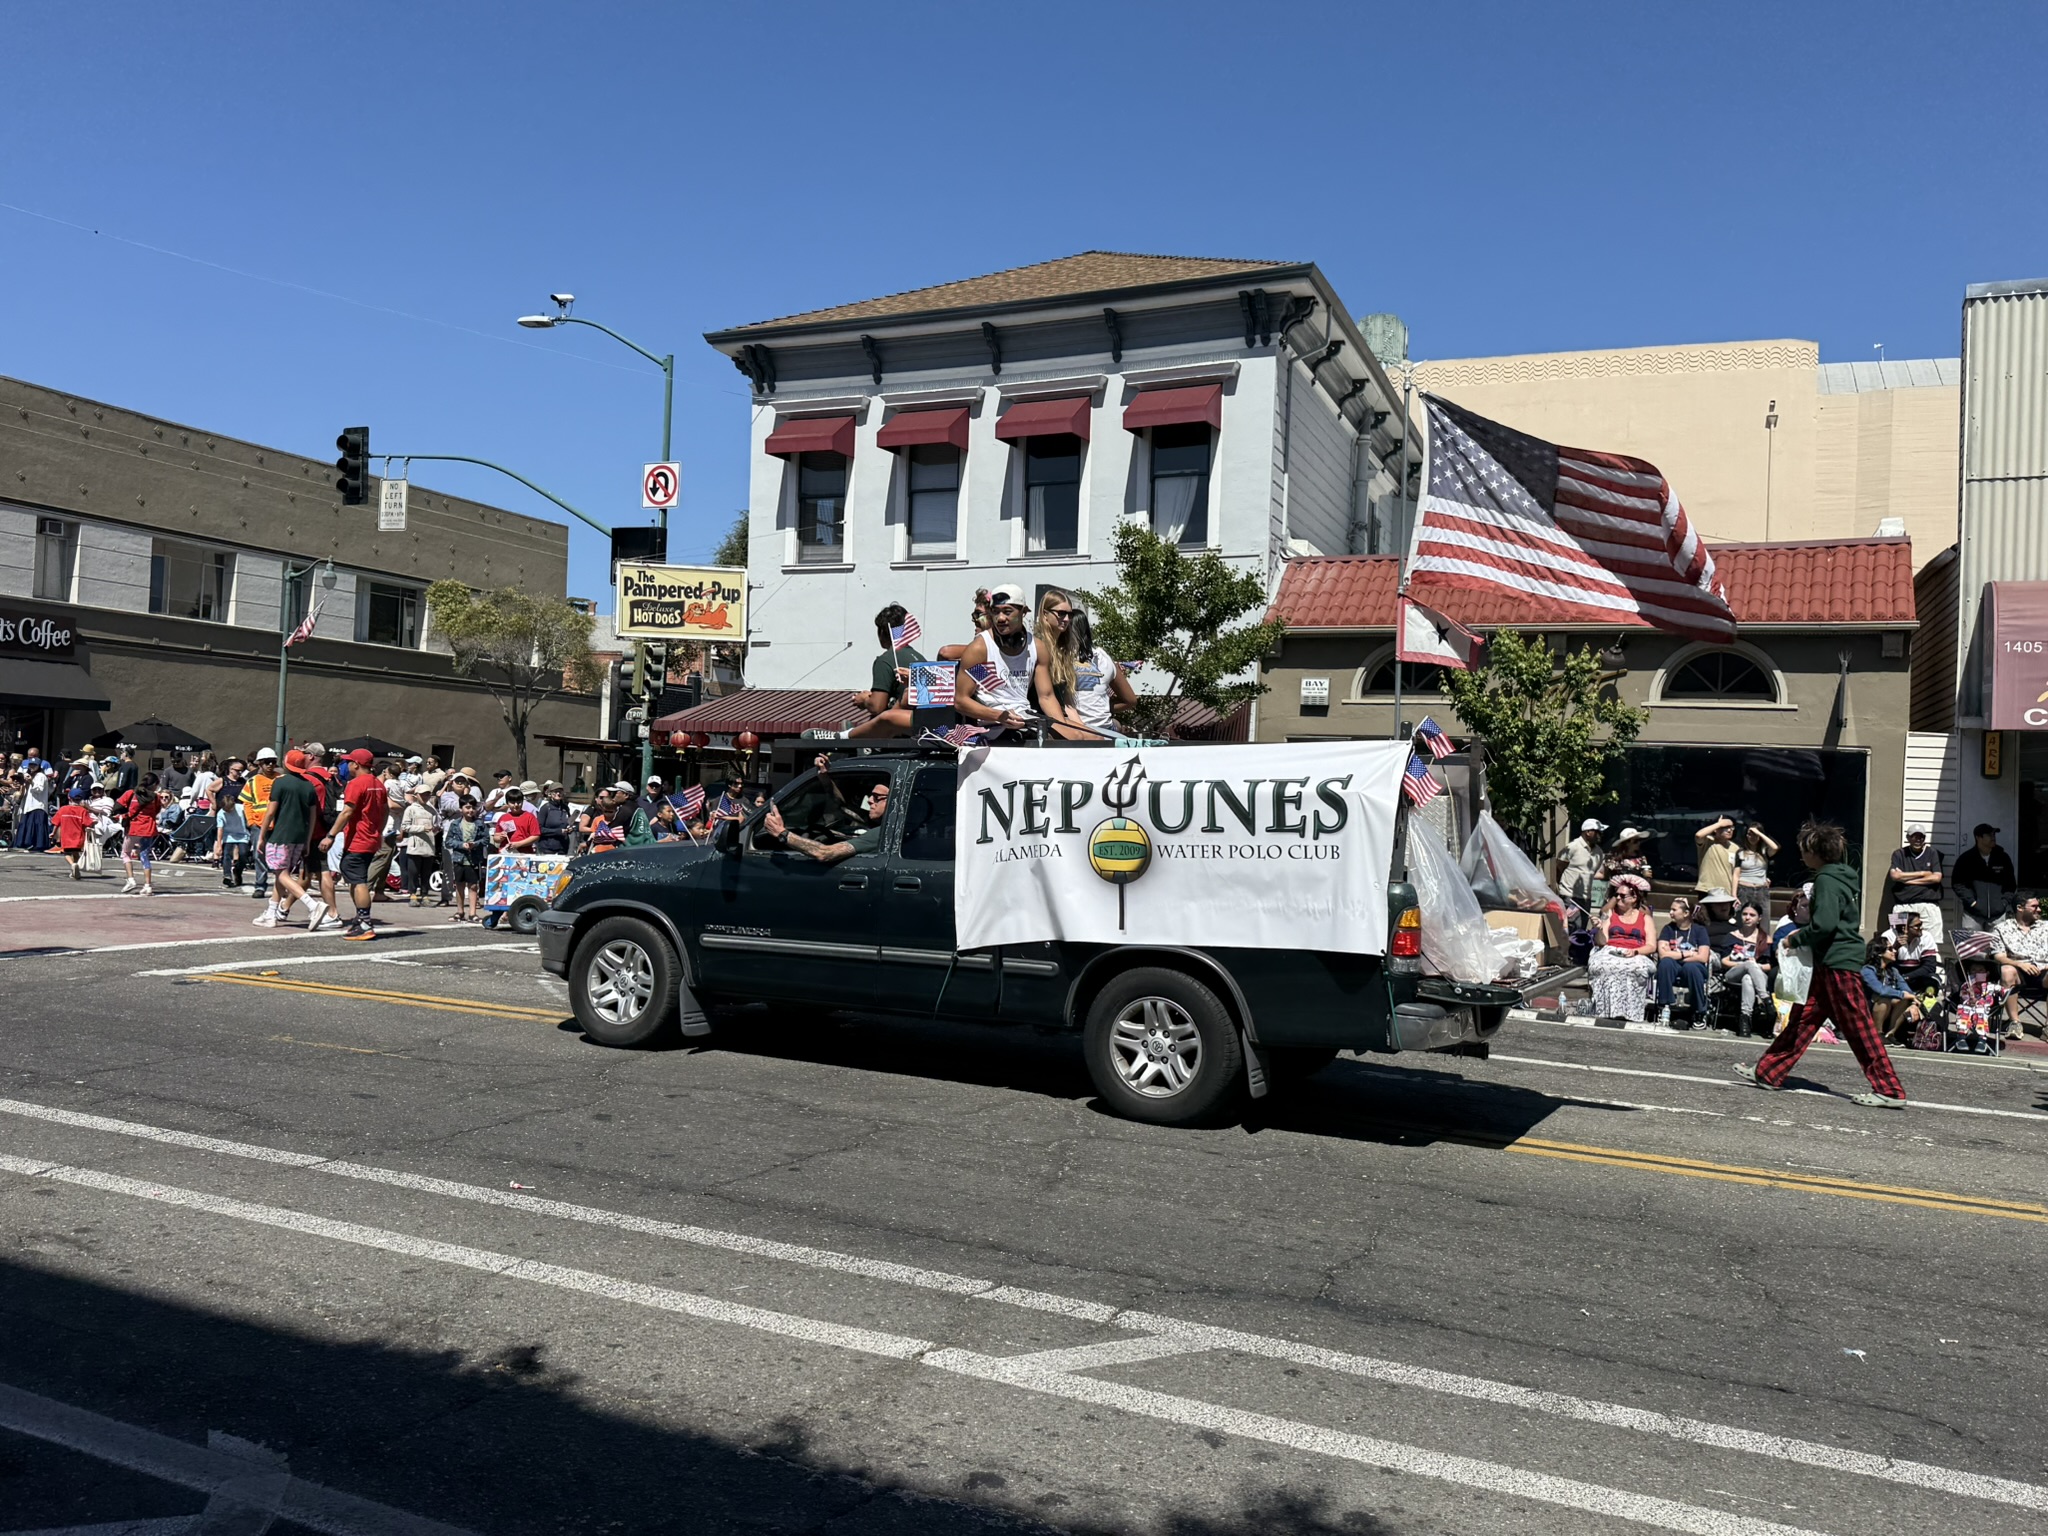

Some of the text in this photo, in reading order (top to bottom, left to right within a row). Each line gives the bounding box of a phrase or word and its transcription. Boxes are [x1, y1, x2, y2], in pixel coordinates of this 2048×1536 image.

[637, 570, 656, 583] The
[623, 576, 741, 604] Pampered Pup
[642, 602, 675, 613] Deluxe
[633, 608, 681, 625] HOT DOGS
[18, 617, 71, 650] Coffee
[2004, 641, 2043, 653] 1405
[2023, 708, 2048, 726] C
[1988, 736, 1997, 770] ARK
[1100, 844, 1141, 856] EST. 2009
[1157, 844, 1341, 861] WATER POLO CLUB
[724, 925, 771, 936] TUNDRA
